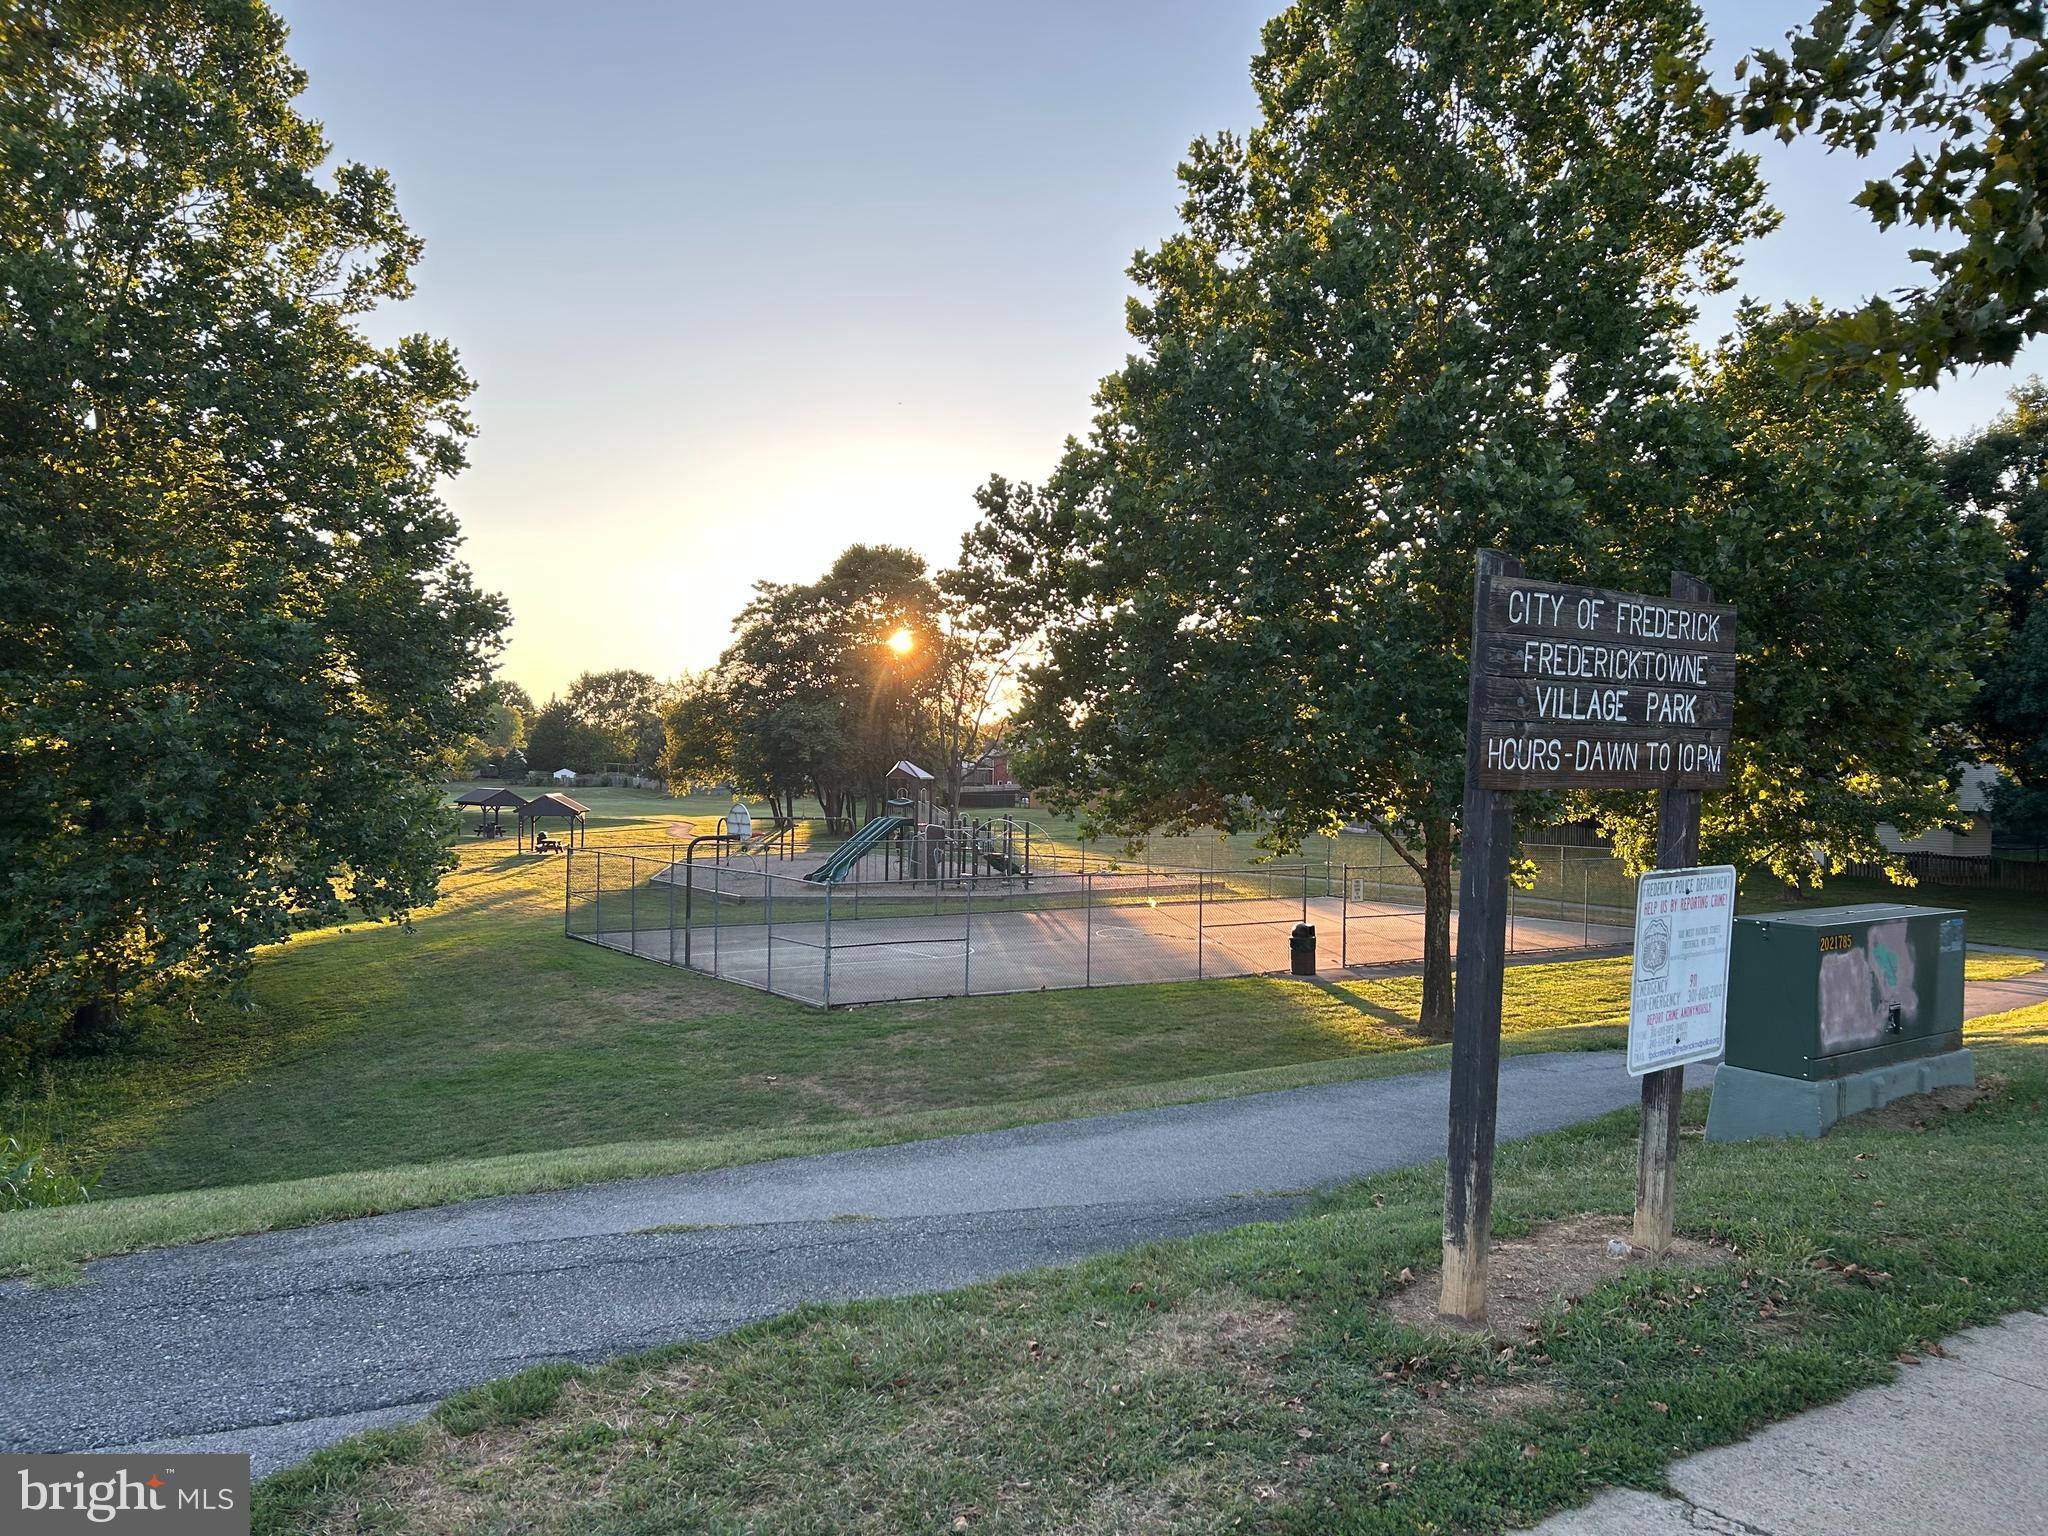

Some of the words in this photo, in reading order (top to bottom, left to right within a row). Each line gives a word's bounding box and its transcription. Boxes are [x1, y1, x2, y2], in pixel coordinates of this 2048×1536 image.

[1508, 590, 1564, 627] CITY
[1577, 598, 1604, 631] OF
[1616, 602, 1720, 643] FREDERICK
[1523, 641, 1708, 685] FREDERICKTOWNE
[1536, 685, 1629, 722] VILLAGE
[1646, 691, 1697, 724] PARK
[1646, 742, 1670, 771] TO
[1643, 880, 1673, 897] FREDERICK
[1675, 878, 1693, 894] POLICE
[1696, 875, 1730, 892] DEPARTMENT
[1643, 900, 1658, 916] HELP
[1660, 899, 1669, 914] US
[1670, 898, 1677, 912] BY
[1680, 895, 1708, 911] REPORTING
[1820, 934, 1852, 952] 2021785
[1636, 979, 1669, 998] EMERGENCY
[1646, 1011, 1664, 1026] REPORT
[1665, 1008, 1679, 1022] CRIME
